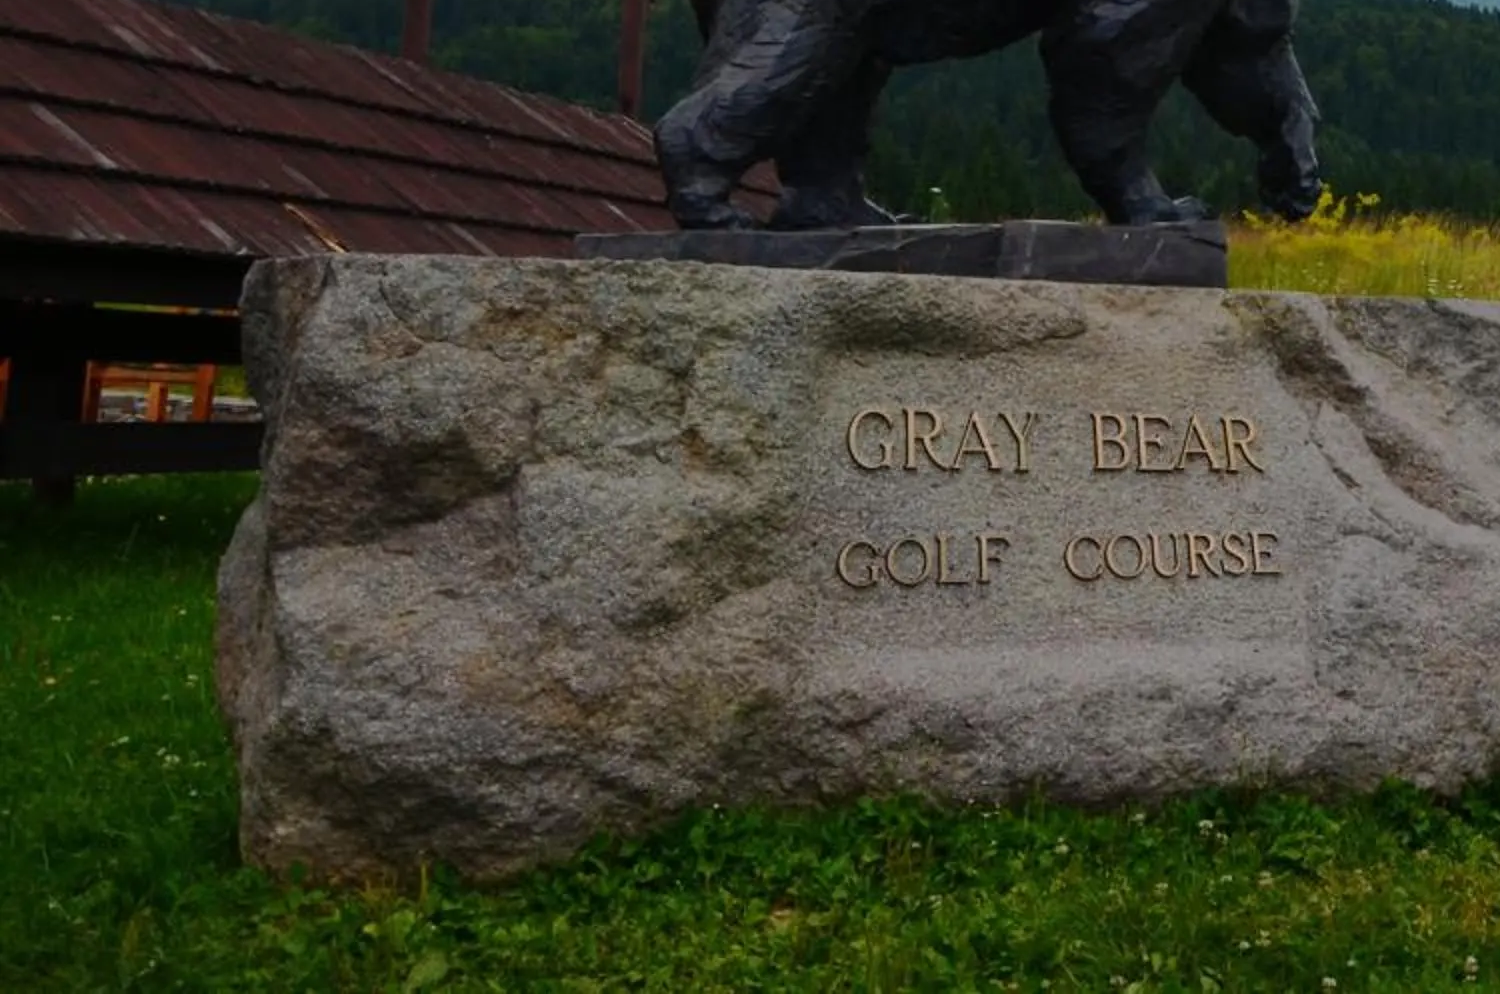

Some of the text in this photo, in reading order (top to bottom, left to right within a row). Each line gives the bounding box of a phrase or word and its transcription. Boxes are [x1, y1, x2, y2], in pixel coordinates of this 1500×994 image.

[847, 408, 1264, 473] GRAY BEAR
[837, 530, 1282, 588] GOLF COURSE
